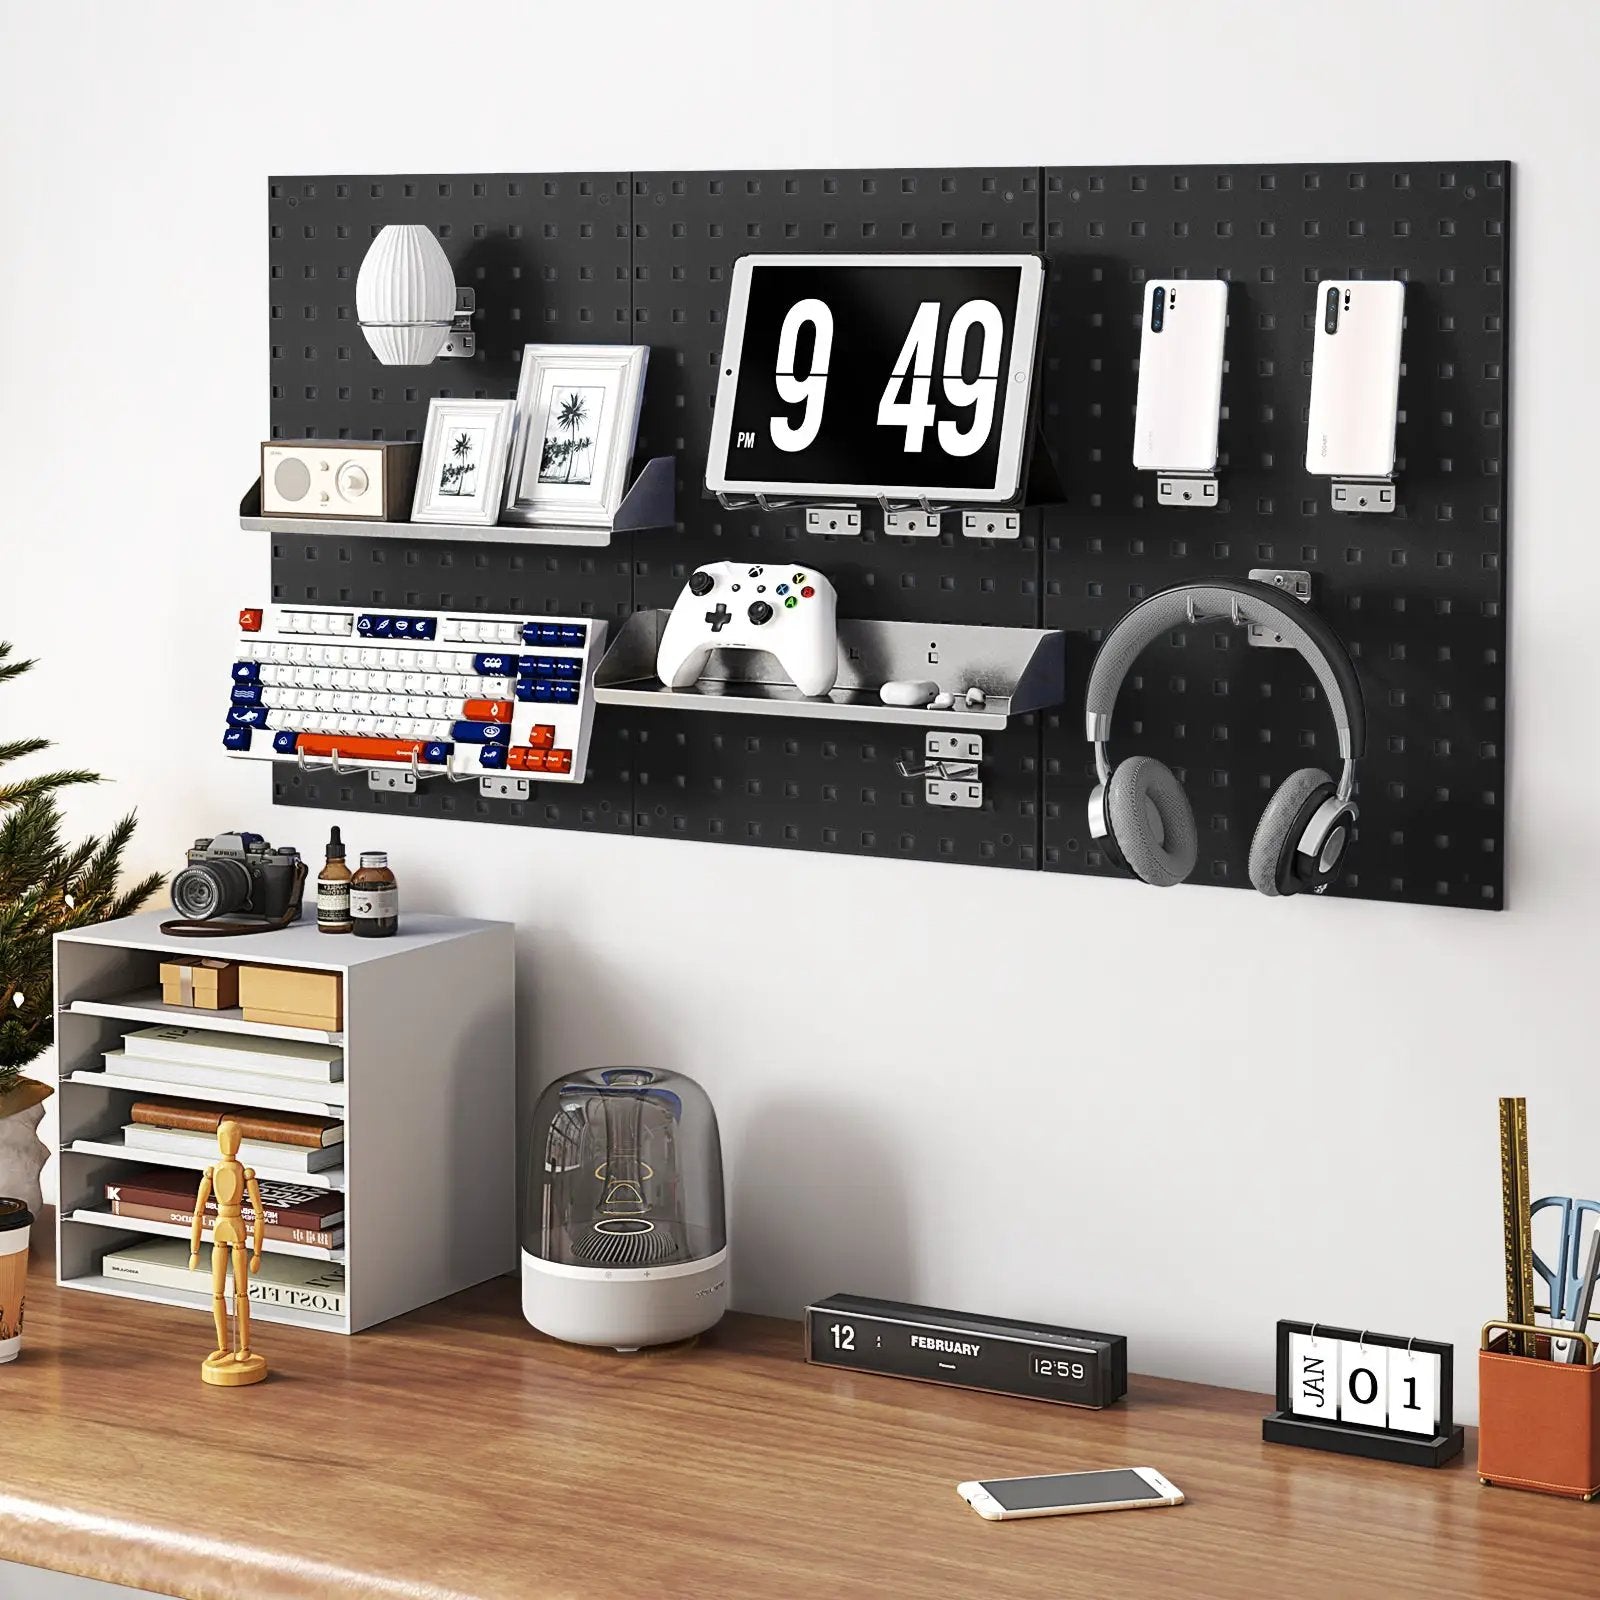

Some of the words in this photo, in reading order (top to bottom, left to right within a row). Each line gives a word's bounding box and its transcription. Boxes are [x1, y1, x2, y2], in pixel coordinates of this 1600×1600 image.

[770, 298, 834, 452] 9
[877, 299, 1004, 457] 49
[737, 432, 755, 449] PM
[831, 1324, 855, 1350] 12
[911, 1335, 980, 1357] FEBRUARY
[1034, 1358, 1084, 1379] 12:59
[1303, 1355, 1325, 1408] JAN
